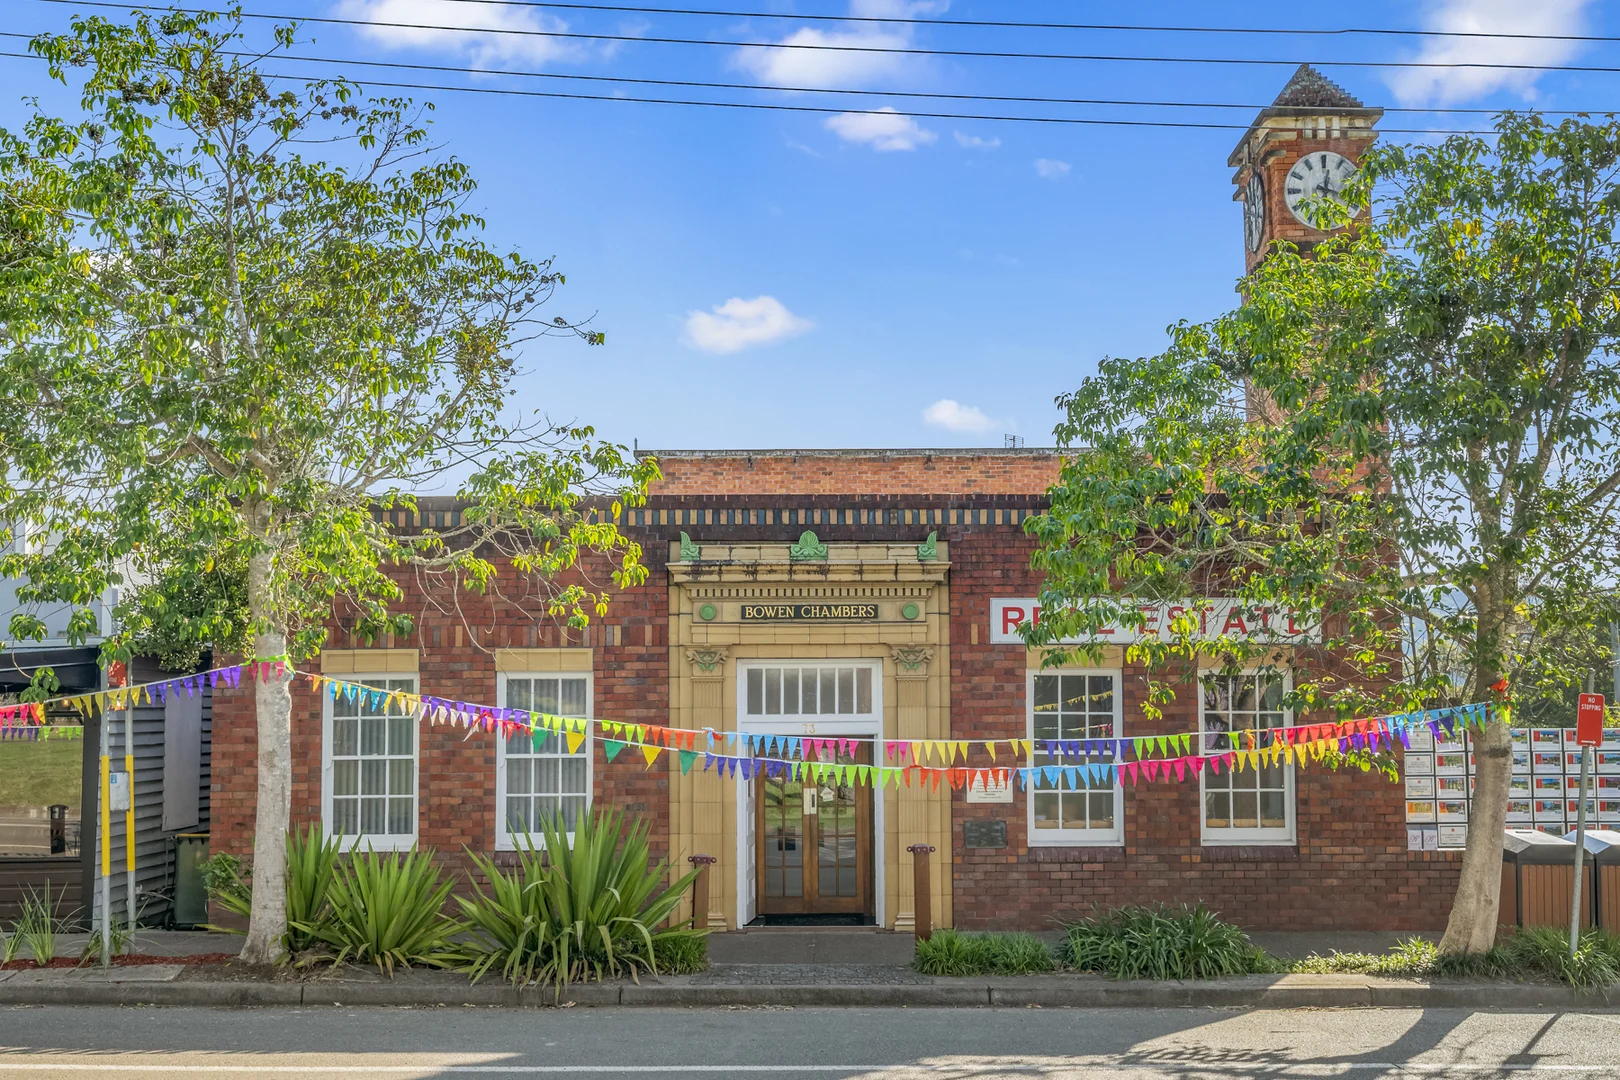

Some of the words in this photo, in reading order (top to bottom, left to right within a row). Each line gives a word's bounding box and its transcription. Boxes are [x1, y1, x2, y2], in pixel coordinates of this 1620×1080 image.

[745, 605, 795, 618] BOWEN
[801, 605, 875, 618] CHAMBERS
[1580, 703, 1602, 712] STOPPING
[802, 723, 816, 734] 73
